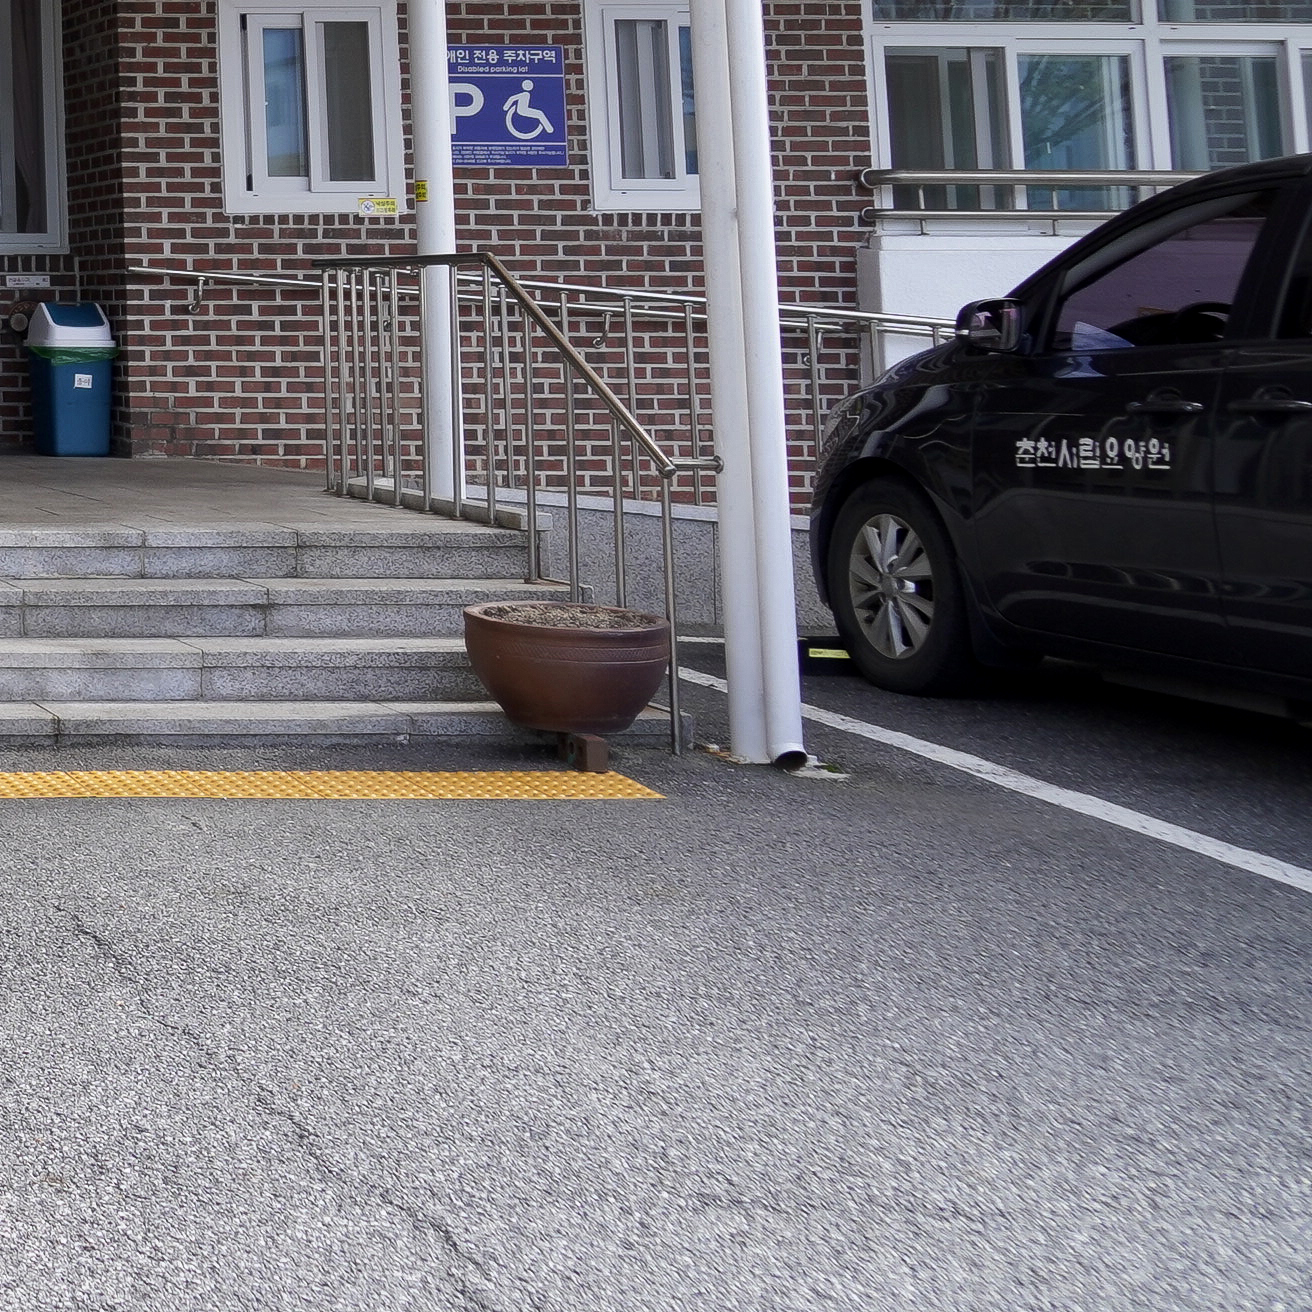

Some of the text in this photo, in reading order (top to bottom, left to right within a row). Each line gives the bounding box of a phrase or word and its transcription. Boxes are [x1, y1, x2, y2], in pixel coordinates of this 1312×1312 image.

[473, 50, 499, 63] 전용
[503, 50, 556, 64] 주차구역
[457, 65, 489, 73] Disabled
[490, 66, 517, 74] parking
[448, 83, 485, 135] P
[1015, 437, 1170, 469] 춘천시립요양원
